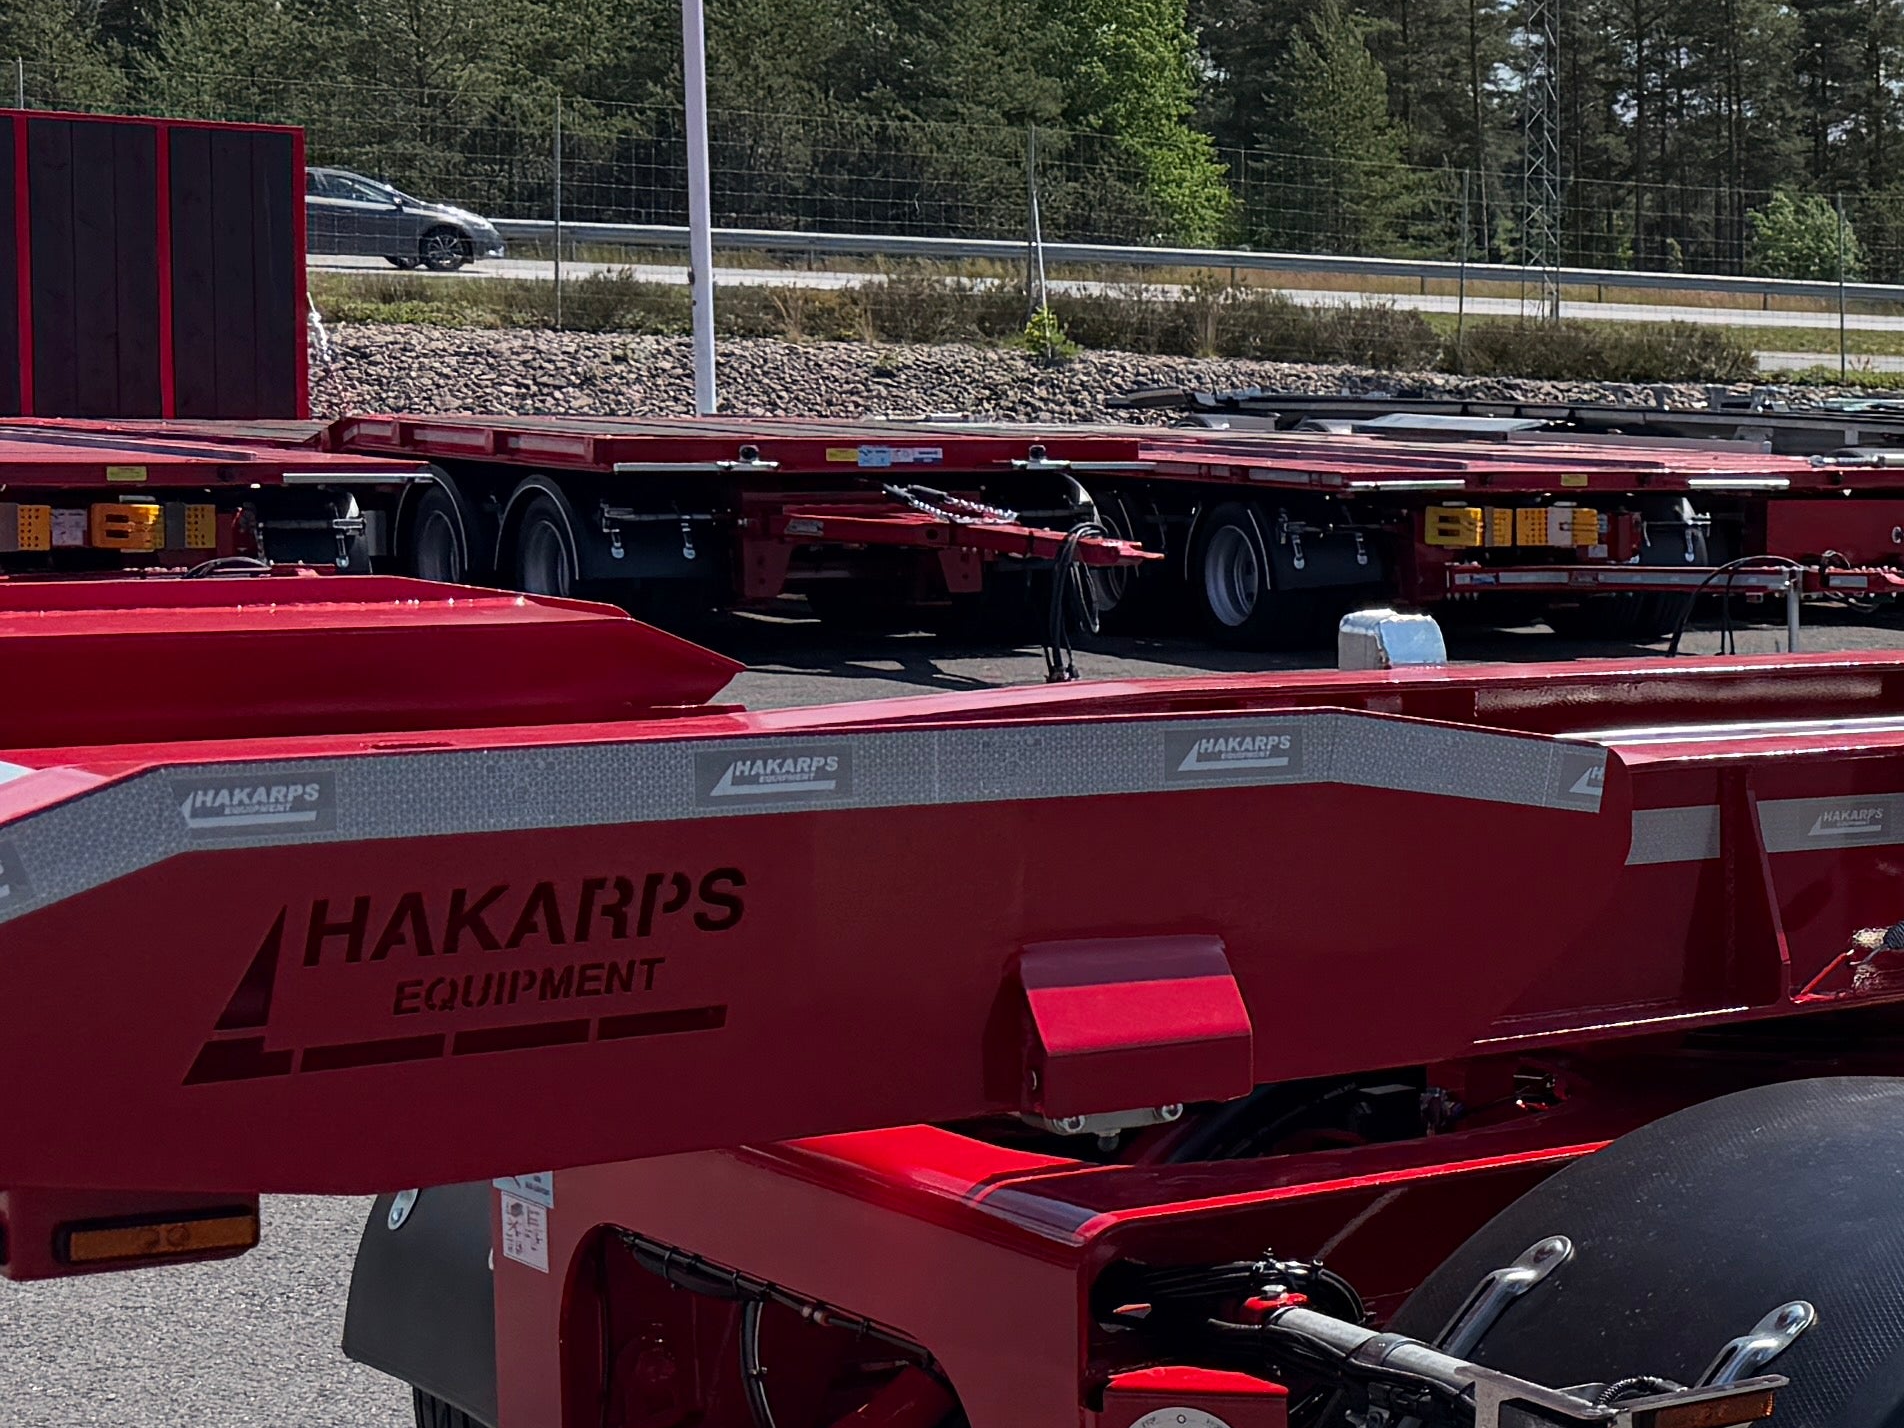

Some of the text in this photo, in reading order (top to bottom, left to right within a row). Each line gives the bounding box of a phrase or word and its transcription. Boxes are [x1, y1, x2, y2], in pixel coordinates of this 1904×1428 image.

[1198, 734, 1292, 754] HAKARPS
[735, 755, 839, 777] HAKARPS
[194, 782, 321, 808] HAKARPS
[302, 866, 748, 967] HAKARPS
[391, 956, 667, 1018] EQUIPMENT
